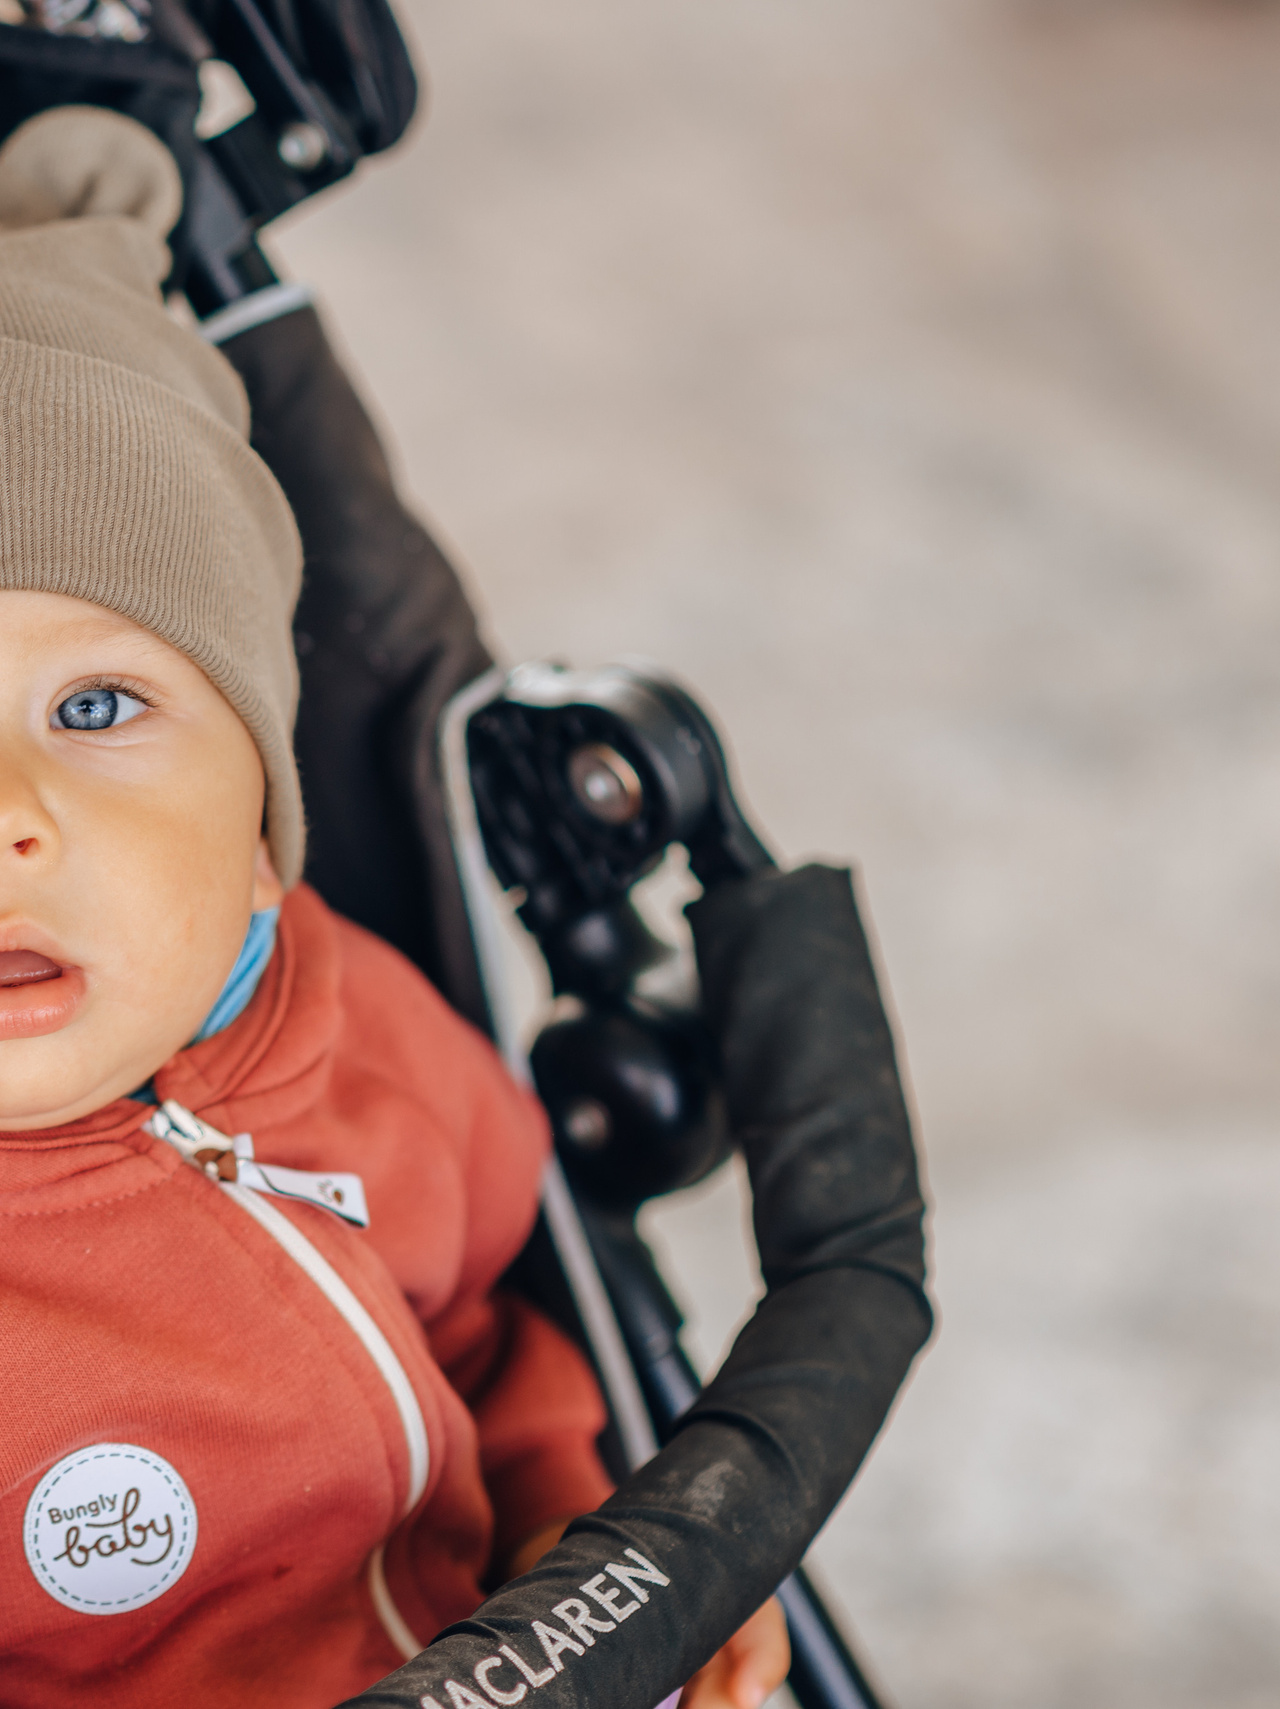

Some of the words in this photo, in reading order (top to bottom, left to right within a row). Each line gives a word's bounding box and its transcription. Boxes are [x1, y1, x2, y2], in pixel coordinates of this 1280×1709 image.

[48, 1493, 118, 1524] Bungly
[53, 1487, 174, 1568] baby
[420, 1547, 670, 1709] ACLAREN
